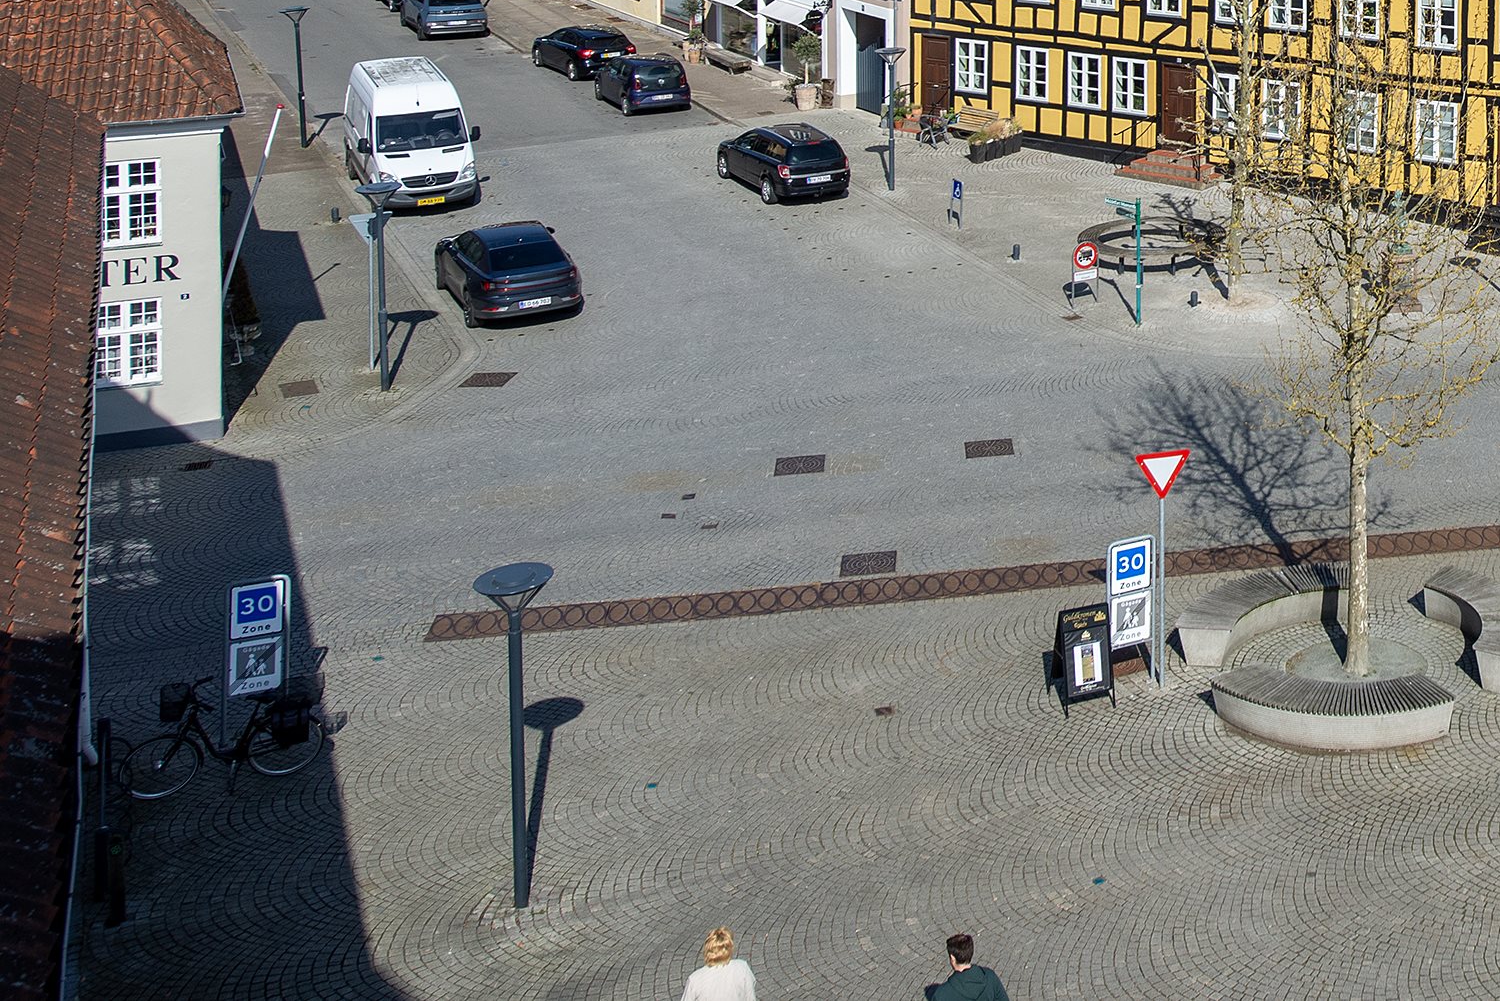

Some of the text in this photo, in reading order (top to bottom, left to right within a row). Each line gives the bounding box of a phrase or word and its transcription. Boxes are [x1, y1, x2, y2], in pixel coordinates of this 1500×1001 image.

[1118, 553, 1144, 573] 30
[1120, 579, 1142, 590] Zone
[240, 594, 274, 615] 30
[242, 623, 271, 635] Zone
[1120, 631, 1142, 641] Zone
[241, 680, 270, 691] Zone
